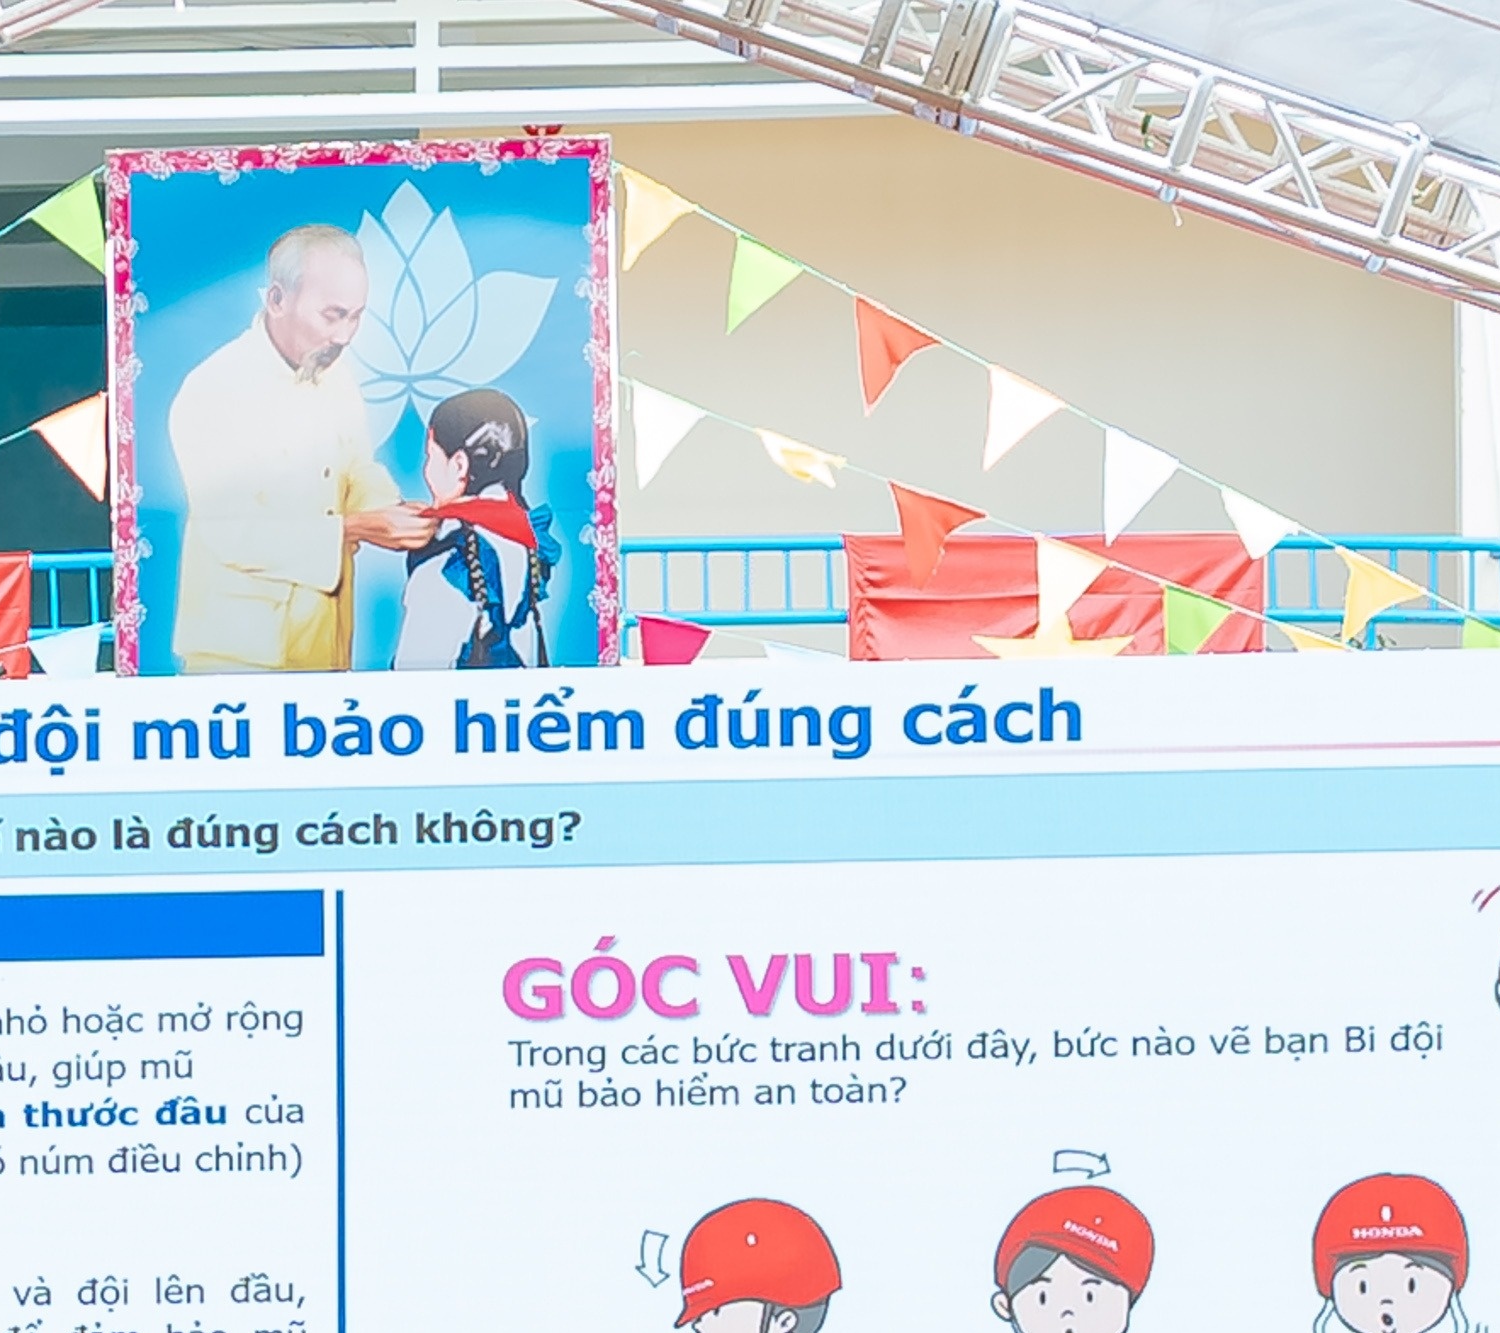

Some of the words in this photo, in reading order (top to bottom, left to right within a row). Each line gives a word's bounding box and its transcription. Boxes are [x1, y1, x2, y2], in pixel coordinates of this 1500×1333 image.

[132, 702, 251, 761] mũ
[283, 698, 425, 759] bảo
[454, 686, 645, 754] hiểm
[674, 688, 872, 761] đúng
[902, 684, 1082, 746] cách
[15, 816, 97, 852] nào
[113, 815, 150, 851] là
[167, 813, 279, 855] đúng
[295, 811, 398, 847] cách
[415, 808, 581, 849] không?
[503, 936, 700, 1022] GÓC
[727, 953, 926, 1018] VUI:
[62, 1004, 143, 1041] hoặc
[158, 1002, 213, 1033] mở
[226, 1000, 303, 1039] rộng
[507, 1040, 606, 1073] Trong
[621, 1034, 679, 1065] các
[692, 1033, 757, 1065] bức
[769, 1034, 861, 1063] tranh
[875, 1029, 952, 1061] dưới
[967, 1028, 1037, 1067] đây,
[1053, 1026, 1117, 1058] bức
[1132, 1025, 1195, 1057] nào
[1209, 1025, 1250, 1055] vẽ
[1265, 1026, 1328, 1061] bạn
[1345, 1025, 1375, 1053] Bi
[1390, 1020, 1443, 1060] đội
[52, 1049, 126, 1089] giúp
[140, 1049, 193, 1080] mũ
[23, 1096, 139, 1128] thước
[155, 1095, 227, 1126] đầu
[245, 1093, 304, 1124] của
[510, 1079, 562, 1109] mũ
[578, 1075, 641, 1108] bảo
[656, 1071, 740, 1107] hiểm
[754, 1084, 796, 1105] an
[810, 1073, 907, 1104] toàn?
[20, 1144, 94, 1175] núm
[108, 1143, 181, 1174] điều
[195, 1141, 302, 1179] chỉnh)
[1351, 1225, 1425, 1240] HONDA
[13, 1275, 52, 1307] và
[77, 1275, 128, 1313] đội
[156, 1274, 205, 1304] lên
[230, 1272, 305, 1309] đầu,
